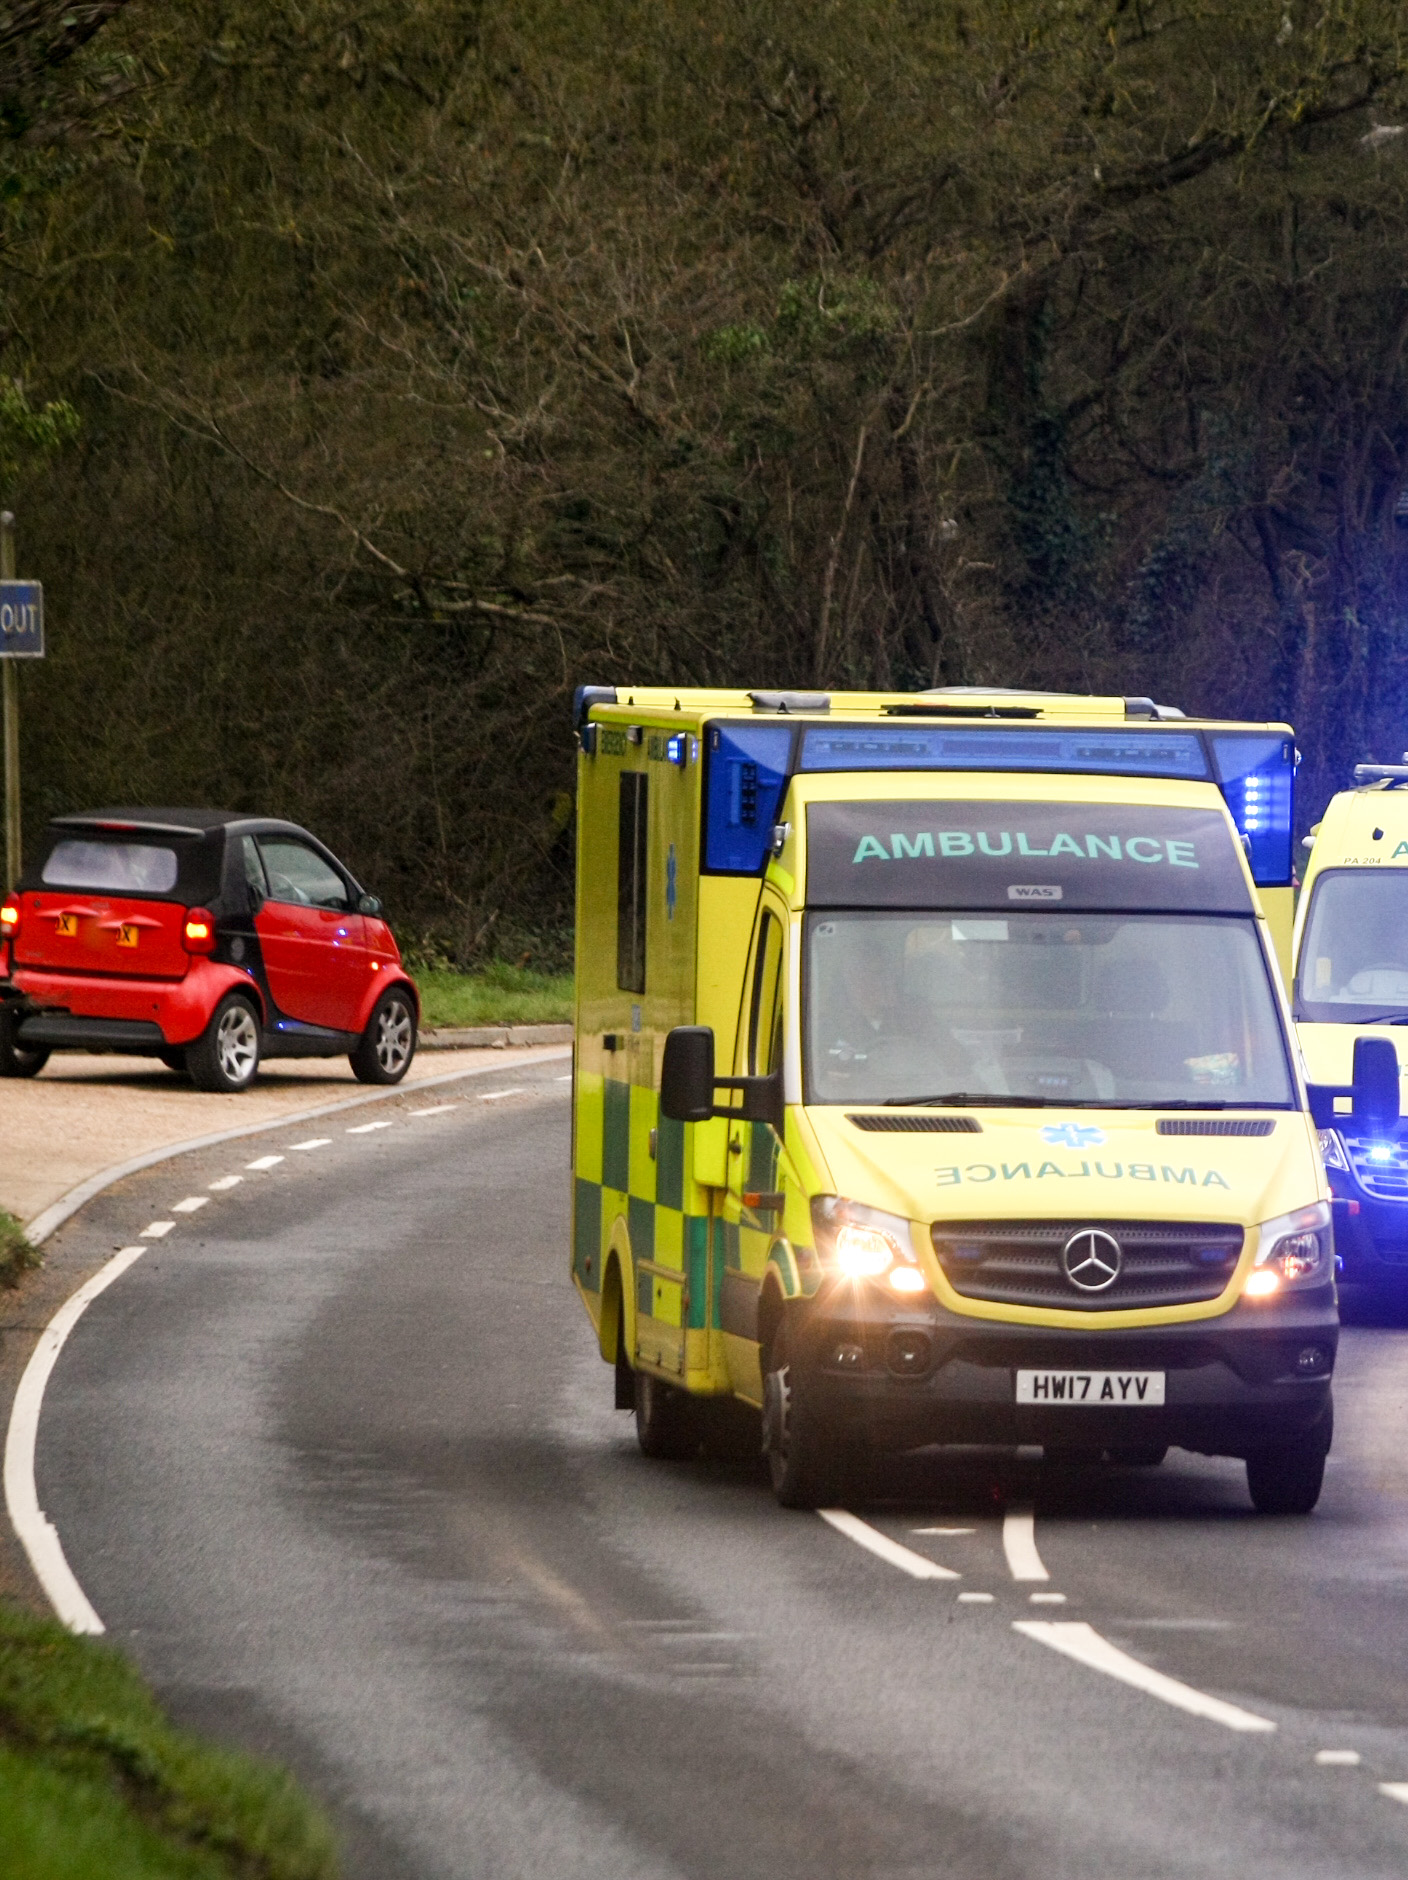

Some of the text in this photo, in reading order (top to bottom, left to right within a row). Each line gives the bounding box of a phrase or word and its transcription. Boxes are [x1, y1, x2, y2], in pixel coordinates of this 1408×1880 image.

[0, 603, 38, 634] OUT
[852, 831, 1199, 868] AMBULANCE
[1343, 857, 1381, 865] PA 204
[1015, 887, 1053, 898] WAS
[1032, 1375, 1149, 1400] HW17 AYV
